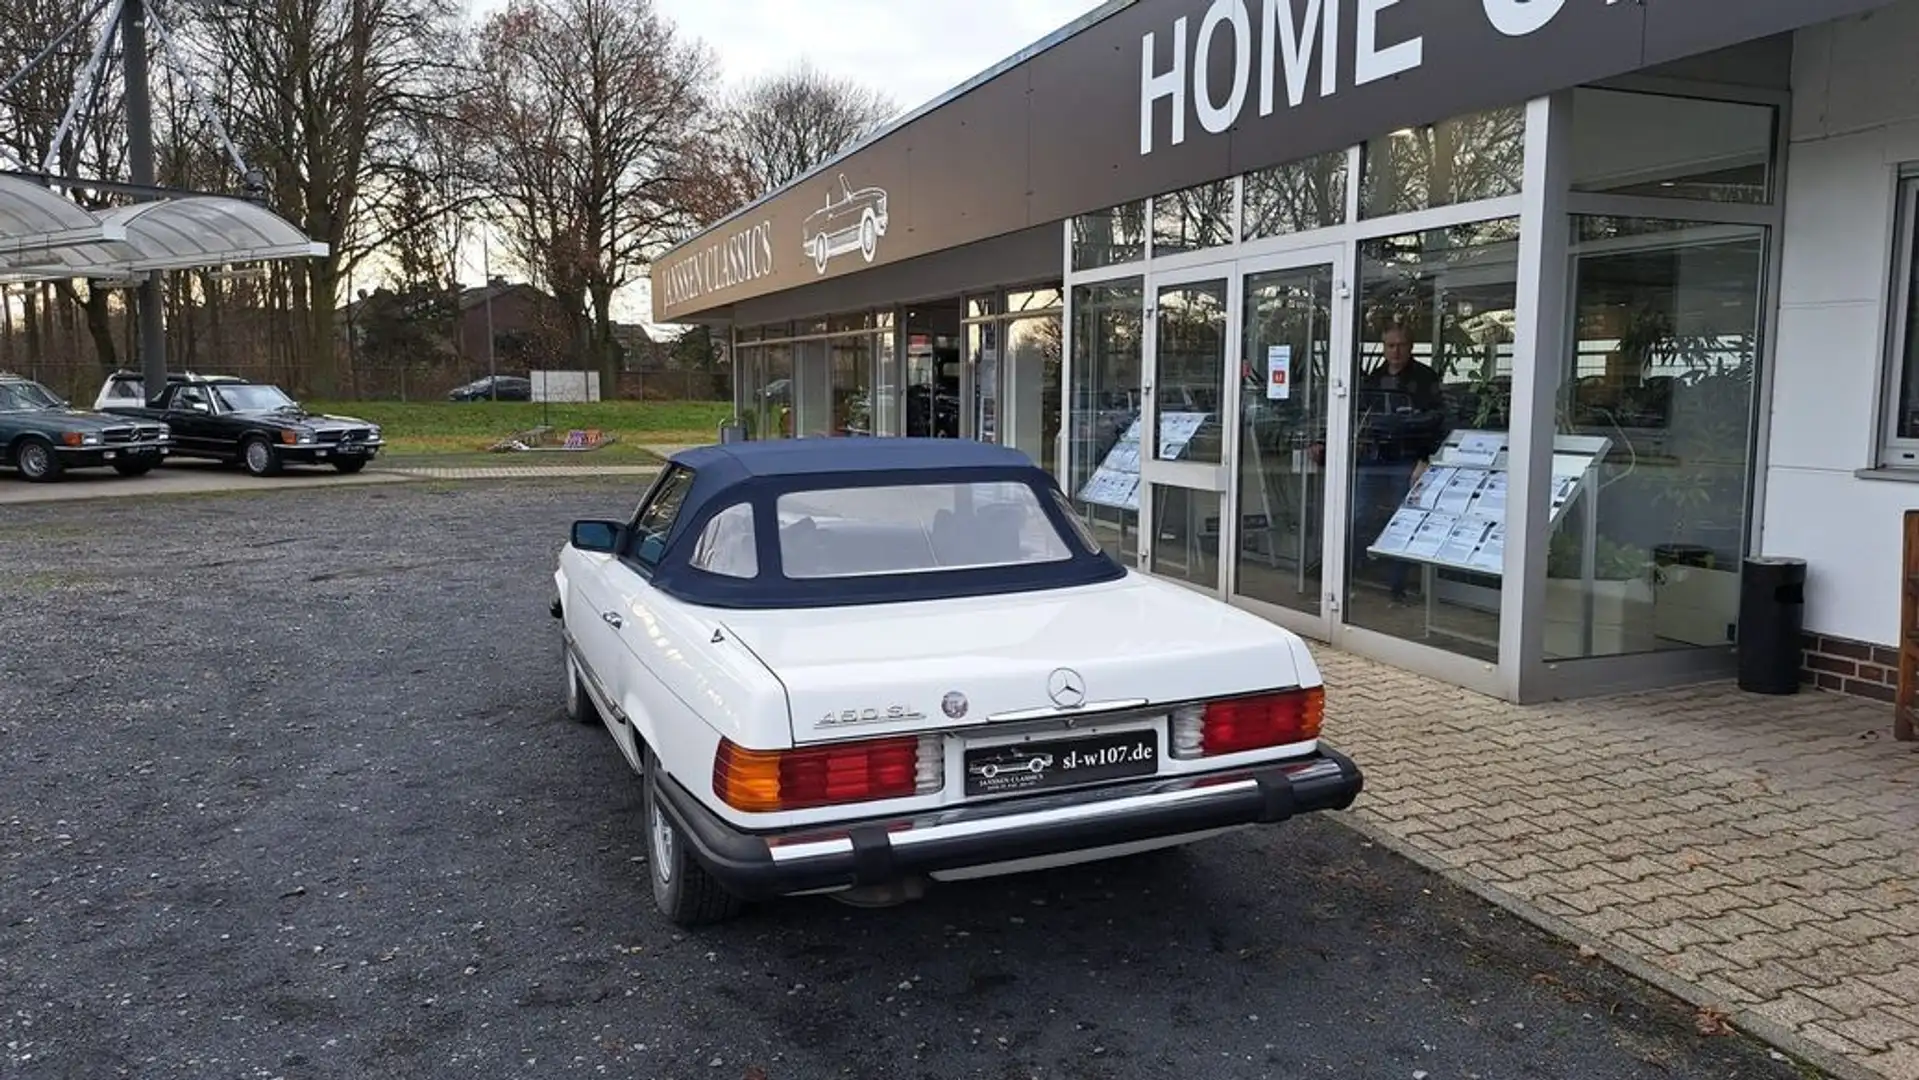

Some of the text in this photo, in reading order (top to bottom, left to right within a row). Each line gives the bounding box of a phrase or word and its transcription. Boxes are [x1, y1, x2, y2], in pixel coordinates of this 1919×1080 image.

[1140, 0, 1423, 155] HOME
[662, 220, 772, 315] JANSSEN CLASSICS
[816, 704, 922, 726] 450 SL
[1062, 743, 1152, 769] sl-w107.de
